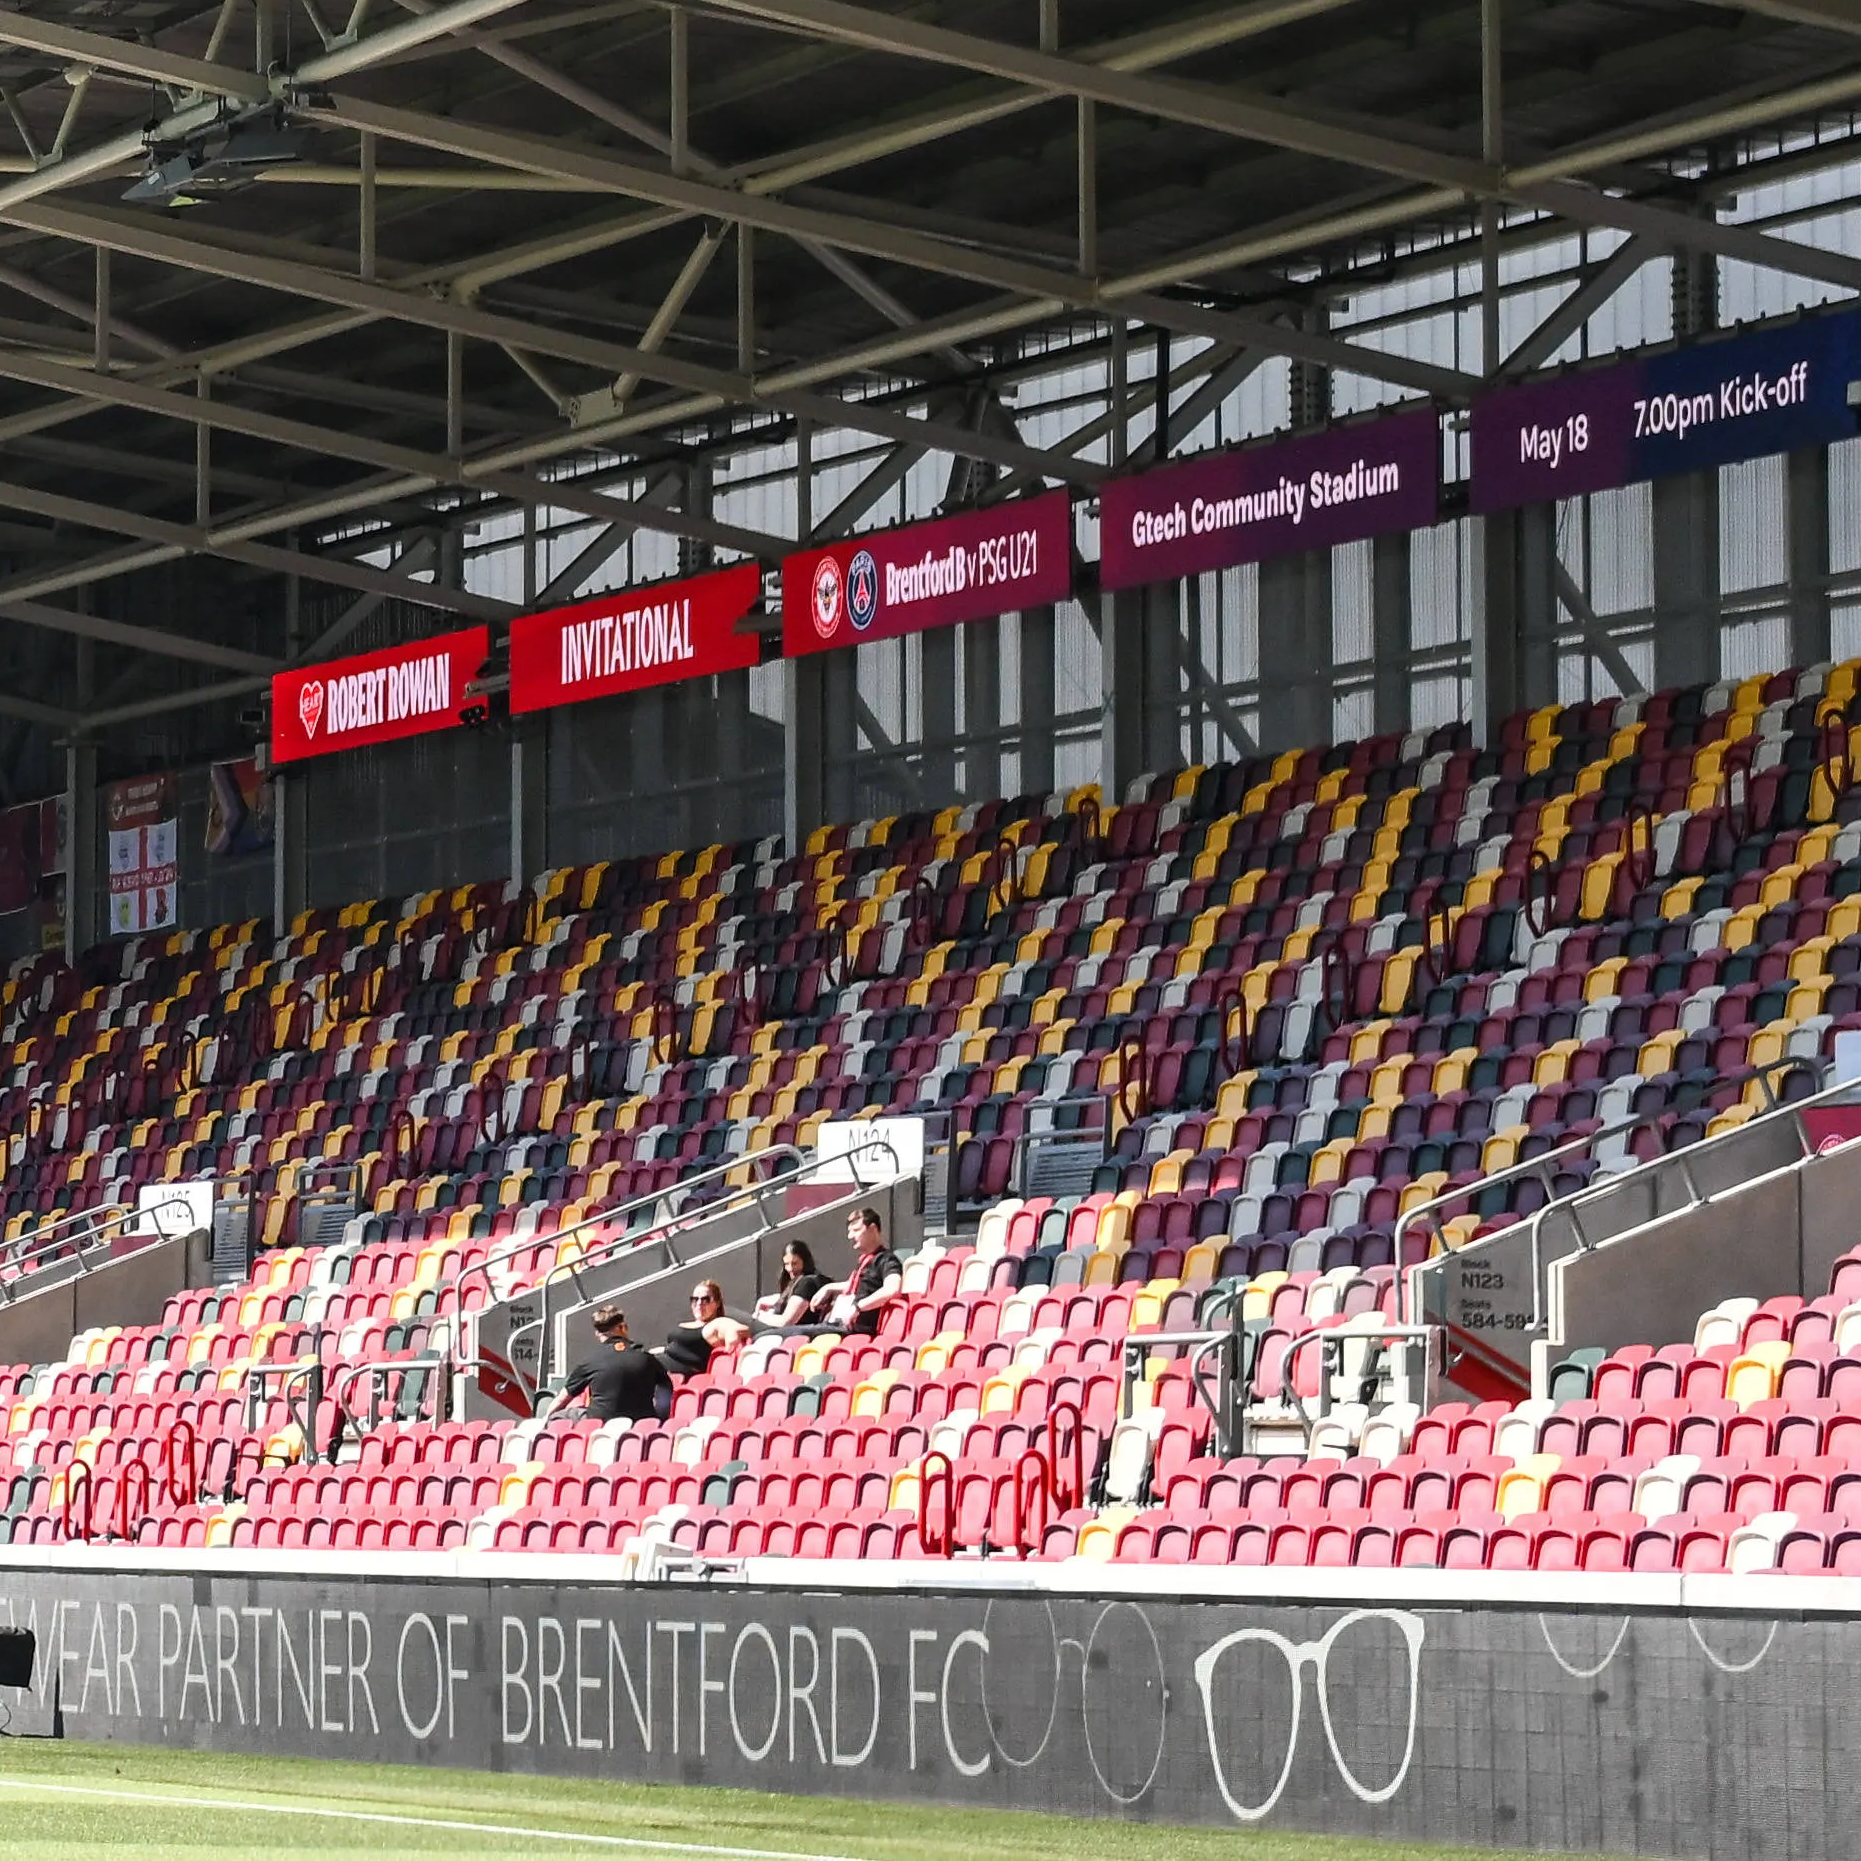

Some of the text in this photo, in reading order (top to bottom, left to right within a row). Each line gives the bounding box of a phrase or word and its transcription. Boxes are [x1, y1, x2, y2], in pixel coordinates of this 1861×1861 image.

[1520, 361, 1808, 469] May 18 7.00pm Kick-off
[1131, 458, 1399, 549] Gtech Community Stadium
[885, 546, 955, 606] Brentford
[967, 552, 976, 588] v
[978, 535, 1007, 586] PSG
[1010, 529, 1037, 579] U21
[560, 597, 694, 685] INVITATIONAL
[326, 666, 383, 735] ROBERT
[387, 652, 451, 724] ROWAN
[848, 1128, 890, 1163] N124
[1461, 1272, 1503, 1289] N123
[159, 1602, 379, 1735] PARTNER
[397, 1612, 469, 1740] OF
[502, 1616, 881, 1768] BRENTFORD
[907, 1628, 991, 1775] FC
